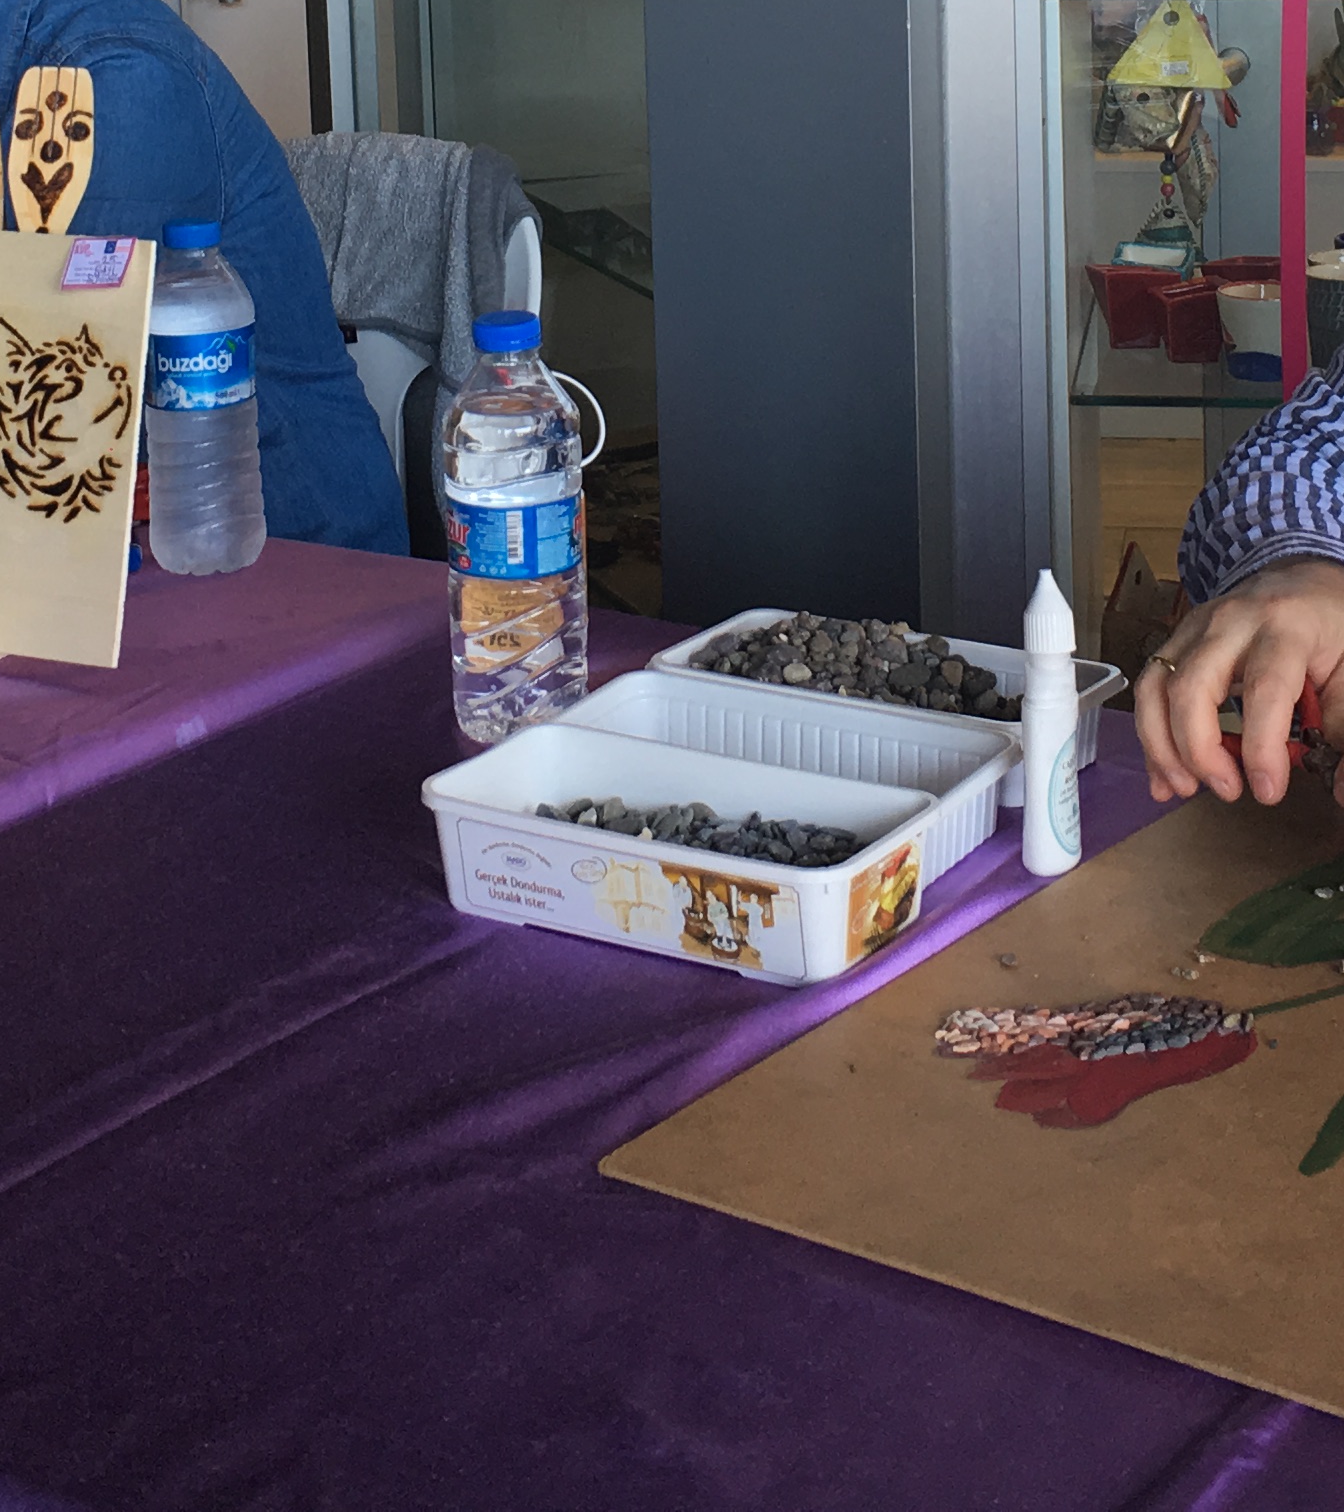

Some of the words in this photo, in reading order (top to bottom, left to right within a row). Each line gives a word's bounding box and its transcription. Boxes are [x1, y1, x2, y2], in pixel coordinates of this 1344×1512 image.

[157, 349, 233, 374] buzdağı
[475, 869, 508, 886] Gerçek
[510, 877, 565, 901] Dondurma,
[488, 887, 522, 905] Ustalık
